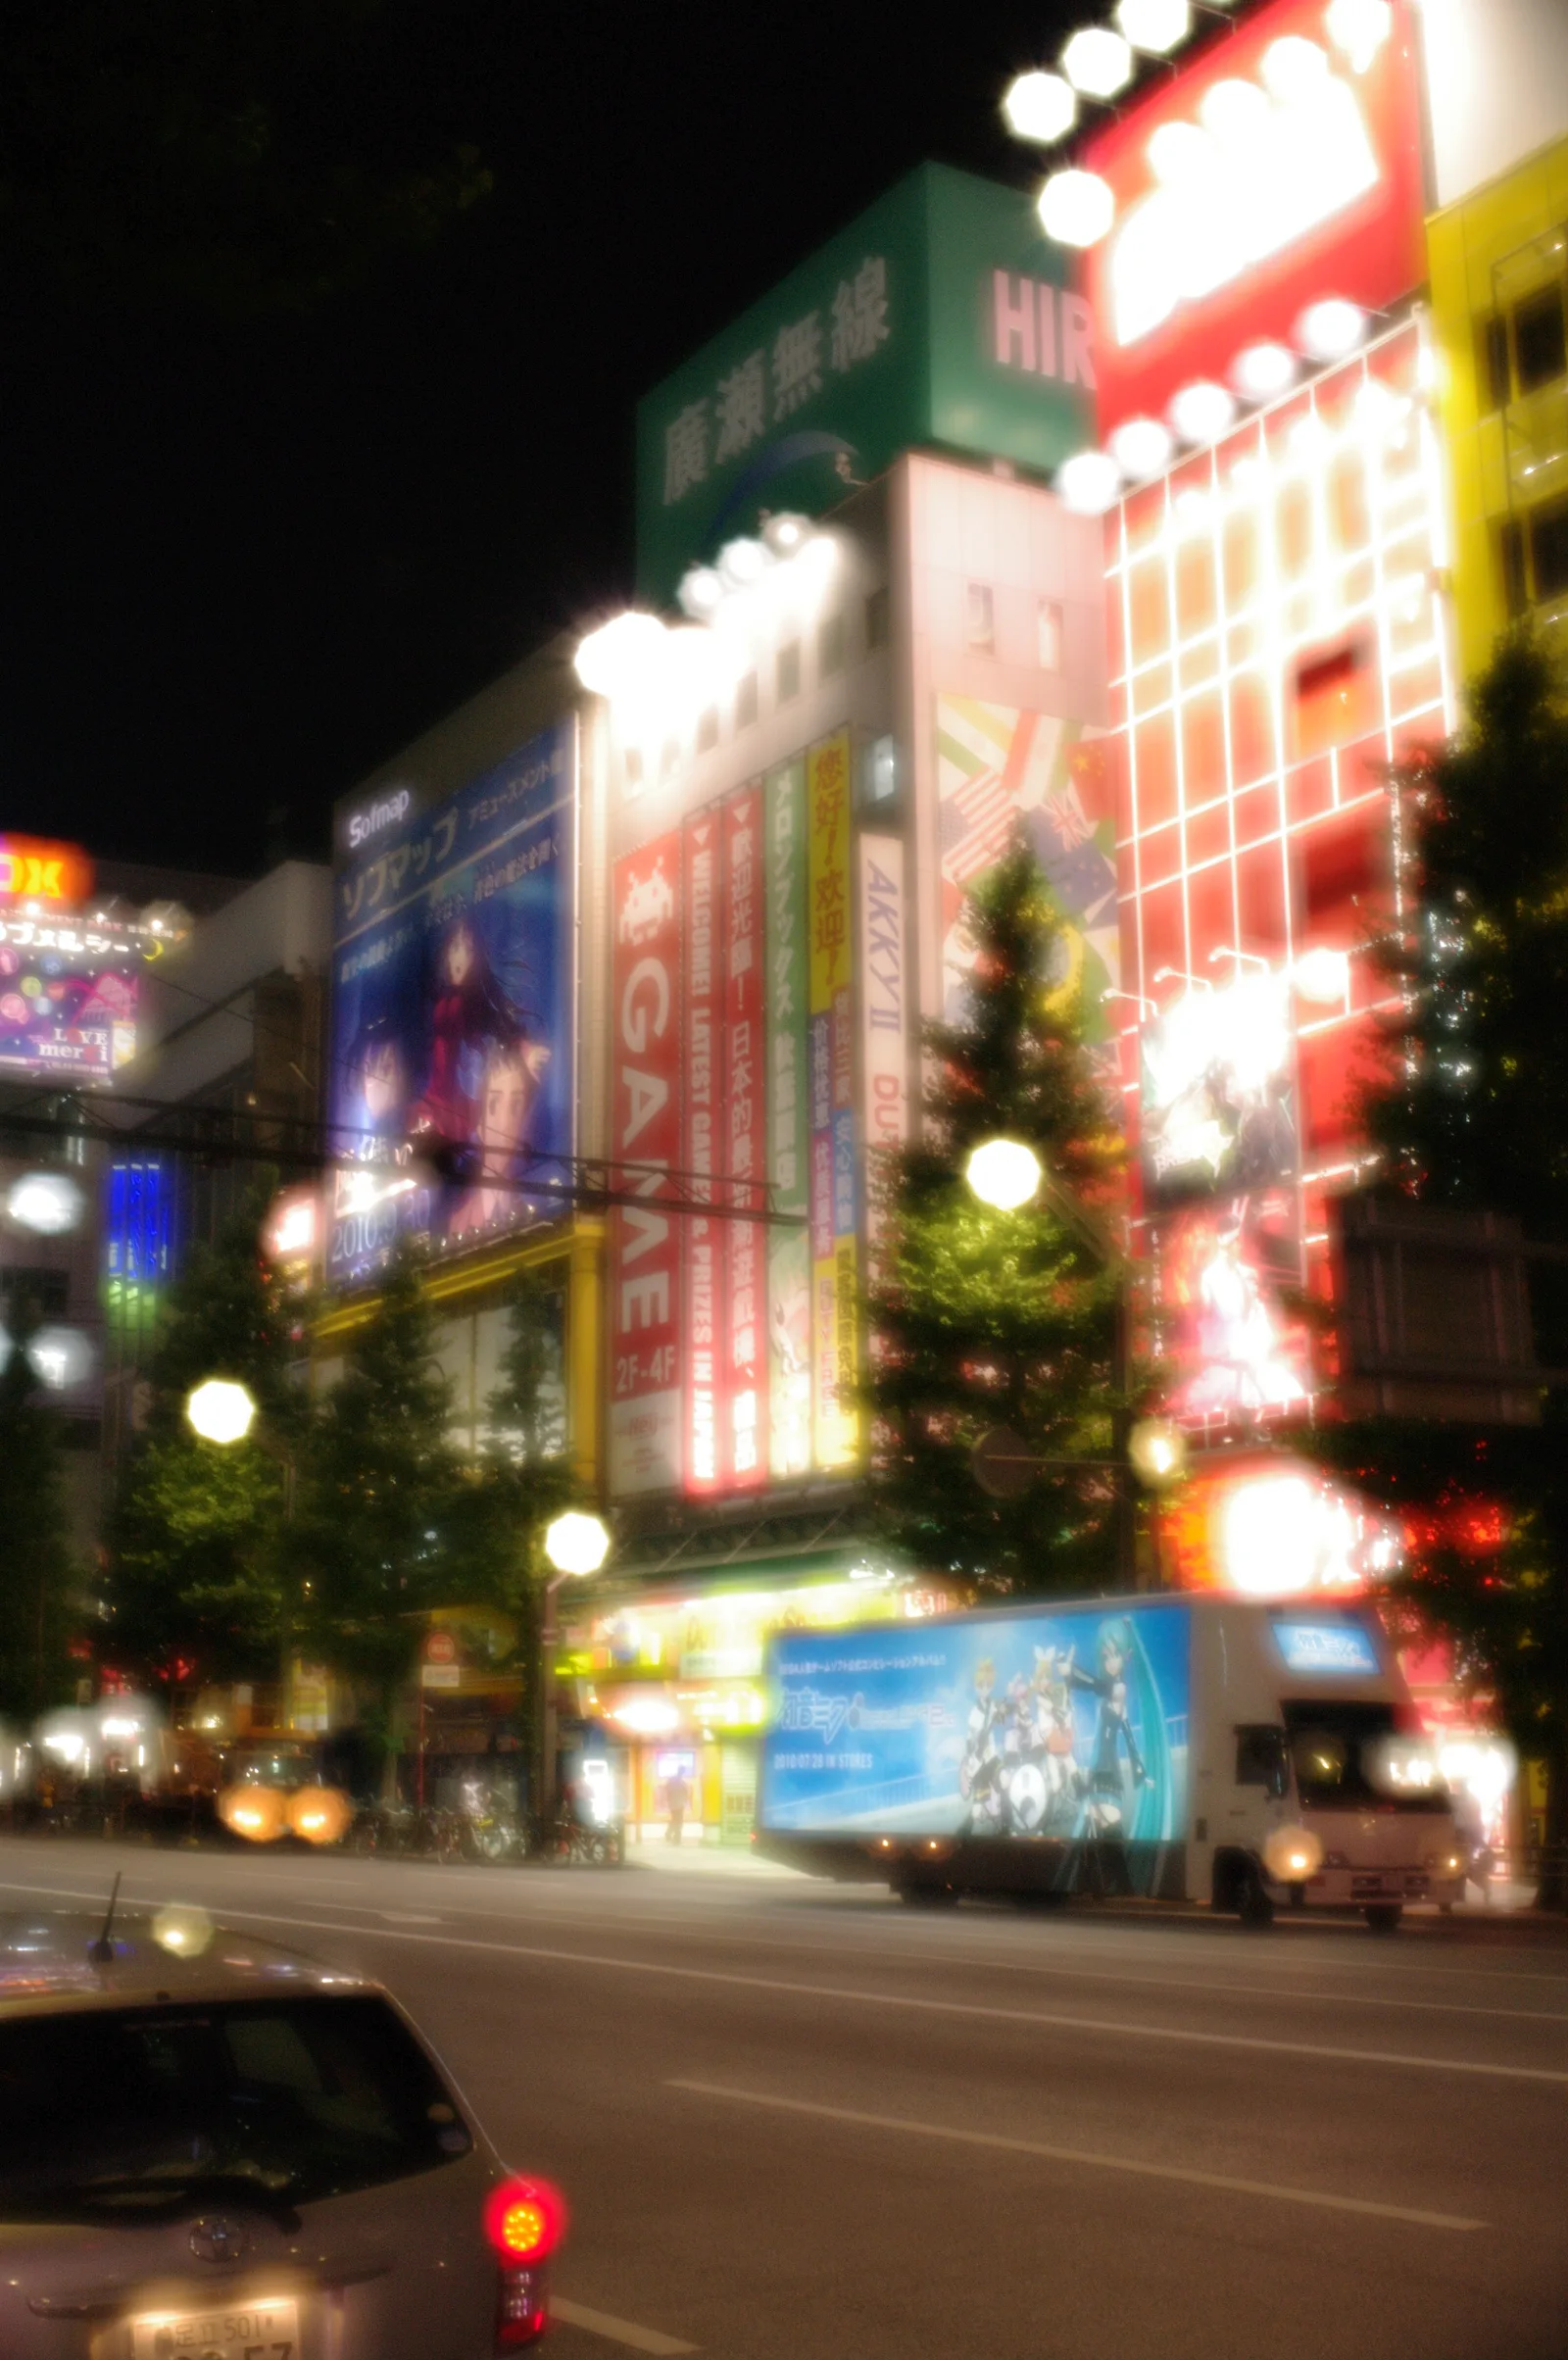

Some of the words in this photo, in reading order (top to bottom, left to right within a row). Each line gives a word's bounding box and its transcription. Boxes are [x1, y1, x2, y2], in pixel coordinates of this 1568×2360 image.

[350, 790, 410, 849] Sofmap
[867, 858, 900, 1004] AKKY
[691, 1008, 711, 1106] LATEST
[620, 957, 671, 1334] GAME
[692, 1246, 713, 1345] PRIZES
[615, 1345, 675, 1393] 2F-4F
